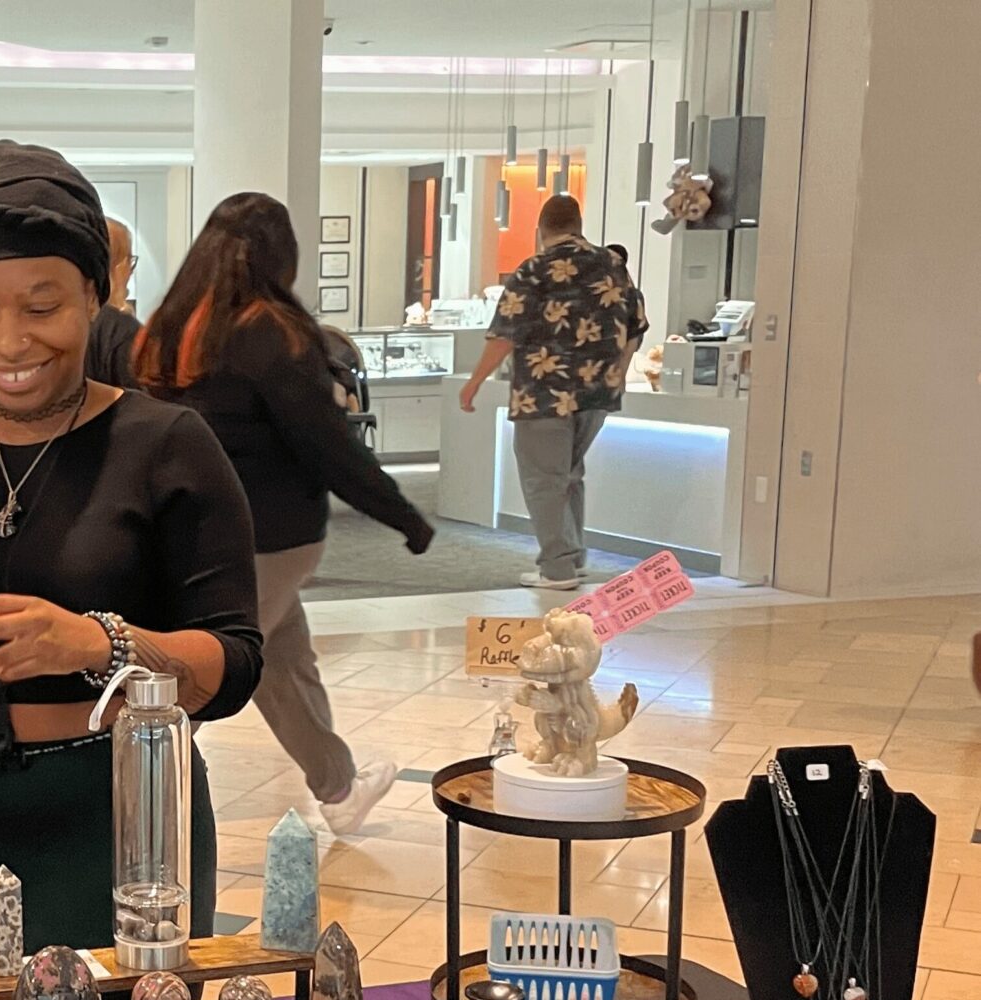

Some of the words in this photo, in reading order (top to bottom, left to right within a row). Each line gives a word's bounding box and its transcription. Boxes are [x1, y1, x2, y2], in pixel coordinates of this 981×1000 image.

[660, 580, 688, 602] TICKET
[621, 601, 651, 623] TICKET
[479, 646, 521, 665] Raffle
